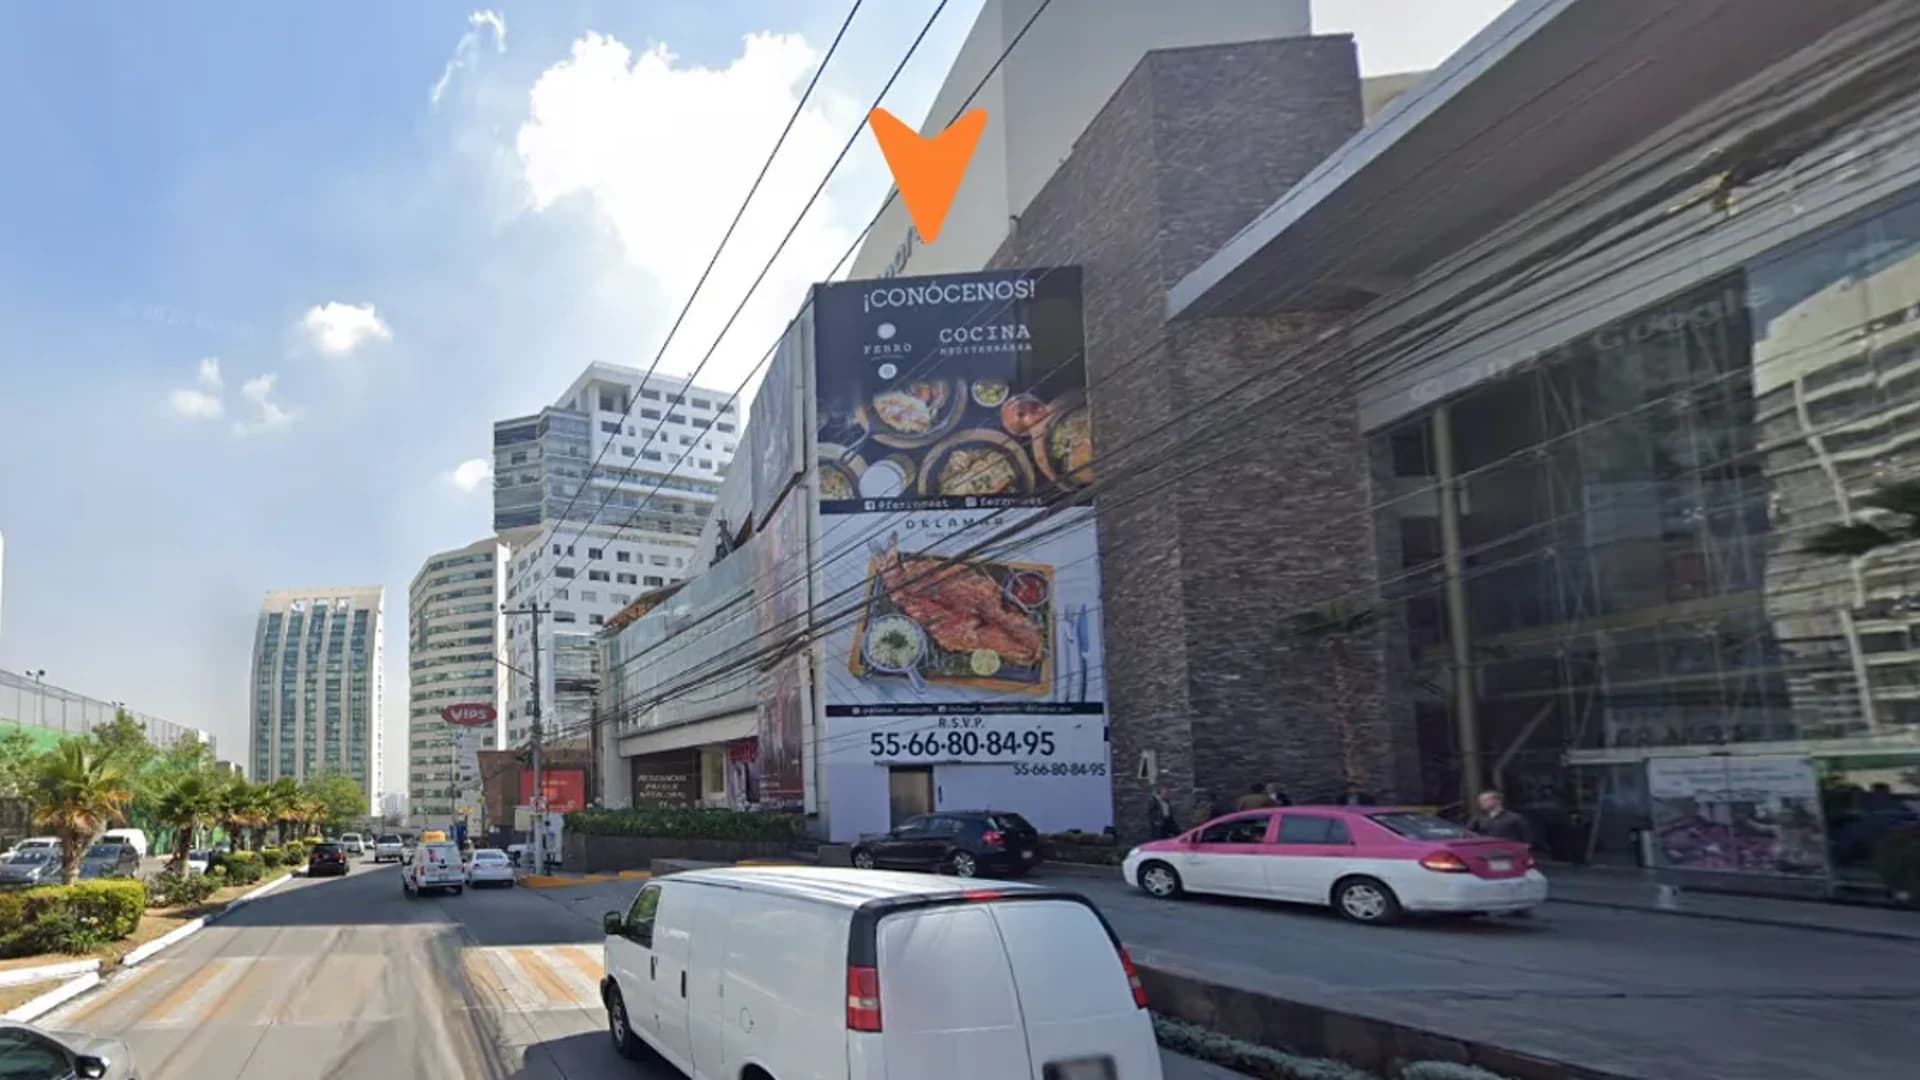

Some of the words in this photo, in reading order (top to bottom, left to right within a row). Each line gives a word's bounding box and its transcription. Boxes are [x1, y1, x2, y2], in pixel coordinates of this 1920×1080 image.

[863, 280, 1035, 312] ¡CONÓCENOS!
[939, 324, 1031, 343] COCINA
[450, 709, 488, 721] VIPS
